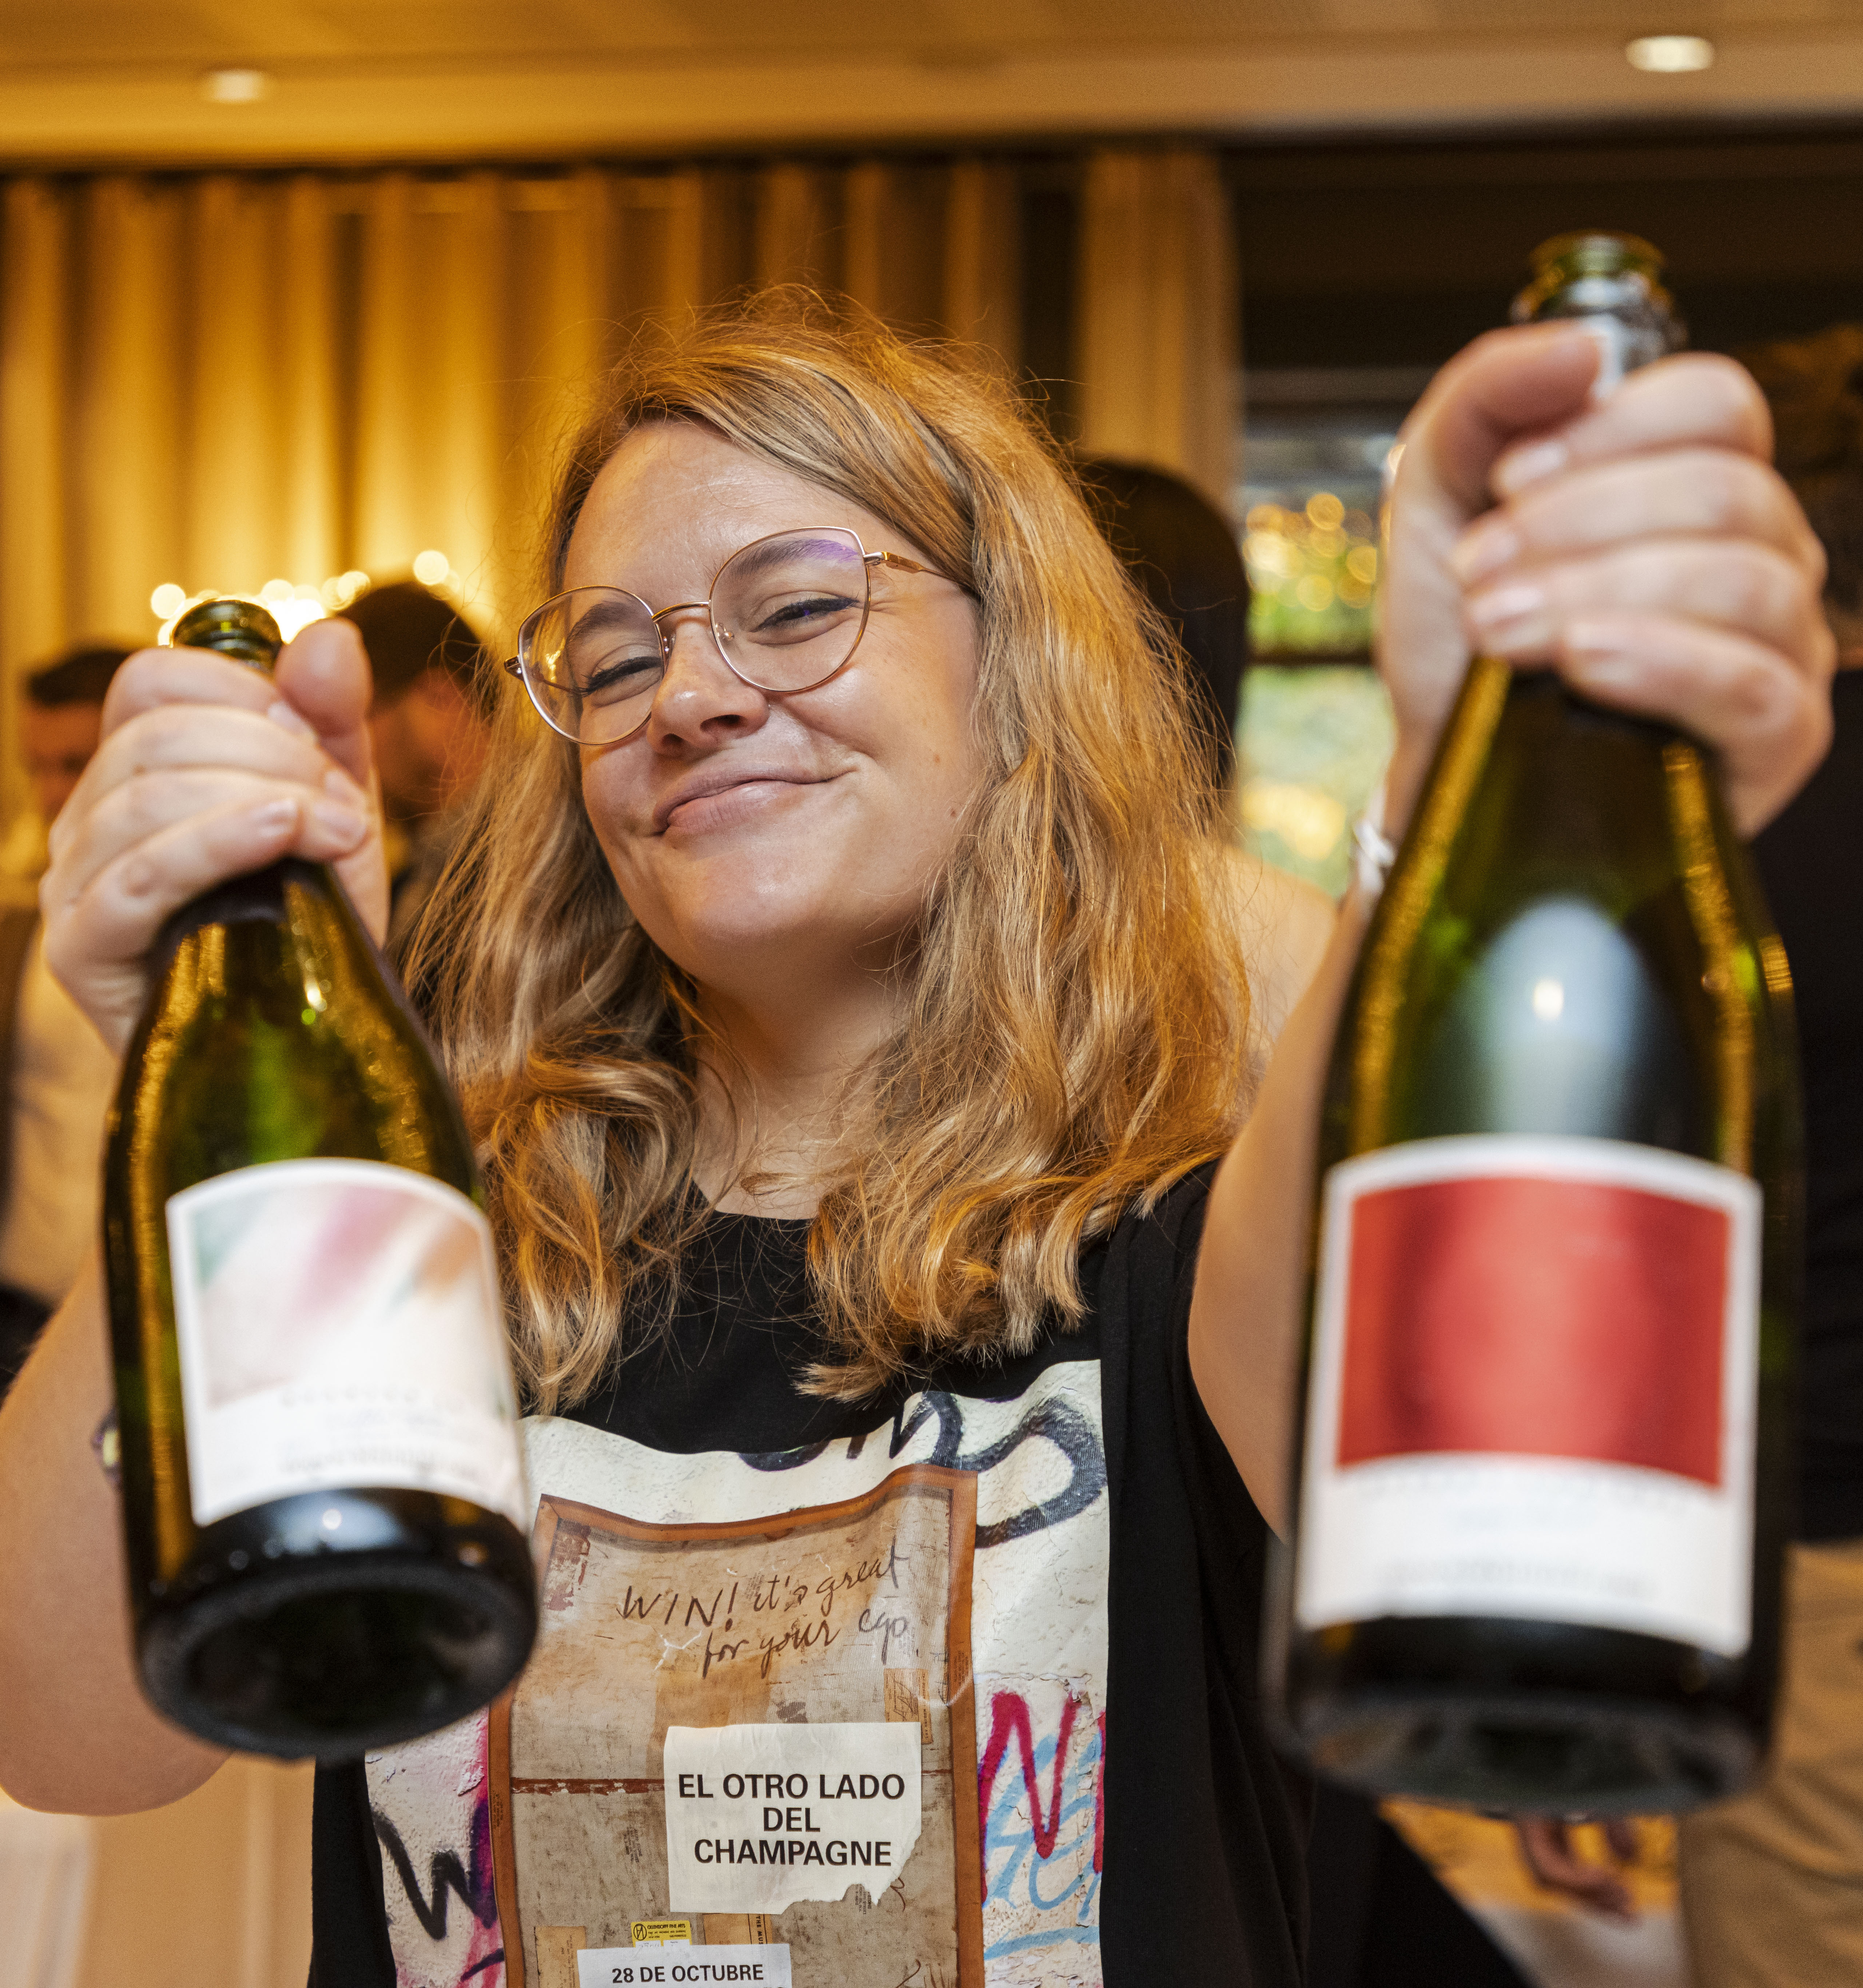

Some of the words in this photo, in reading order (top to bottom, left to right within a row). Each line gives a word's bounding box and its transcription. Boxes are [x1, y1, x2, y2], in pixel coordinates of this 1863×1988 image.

[621, 1582, 739, 1632] WIN!
[753, 1574, 808, 1612] it's
[816, 1535, 909, 1617] great
[702, 1631, 750, 1679] for
[759, 1619, 841, 1680] your
[679, 1774, 714, 1798] EL
[723, 1773, 808, 1799] OTRO
[820, 1774, 905, 1800] LADO
[763, 1807, 821, 1832] DEL
[695, 1839, 891, 1866] CHAMPAGNE
[612, 1968, 634, 1984] 28
[640, 1966, 665, 1982] DE
[672, 1964, 764, 1982] OCTUBRE
